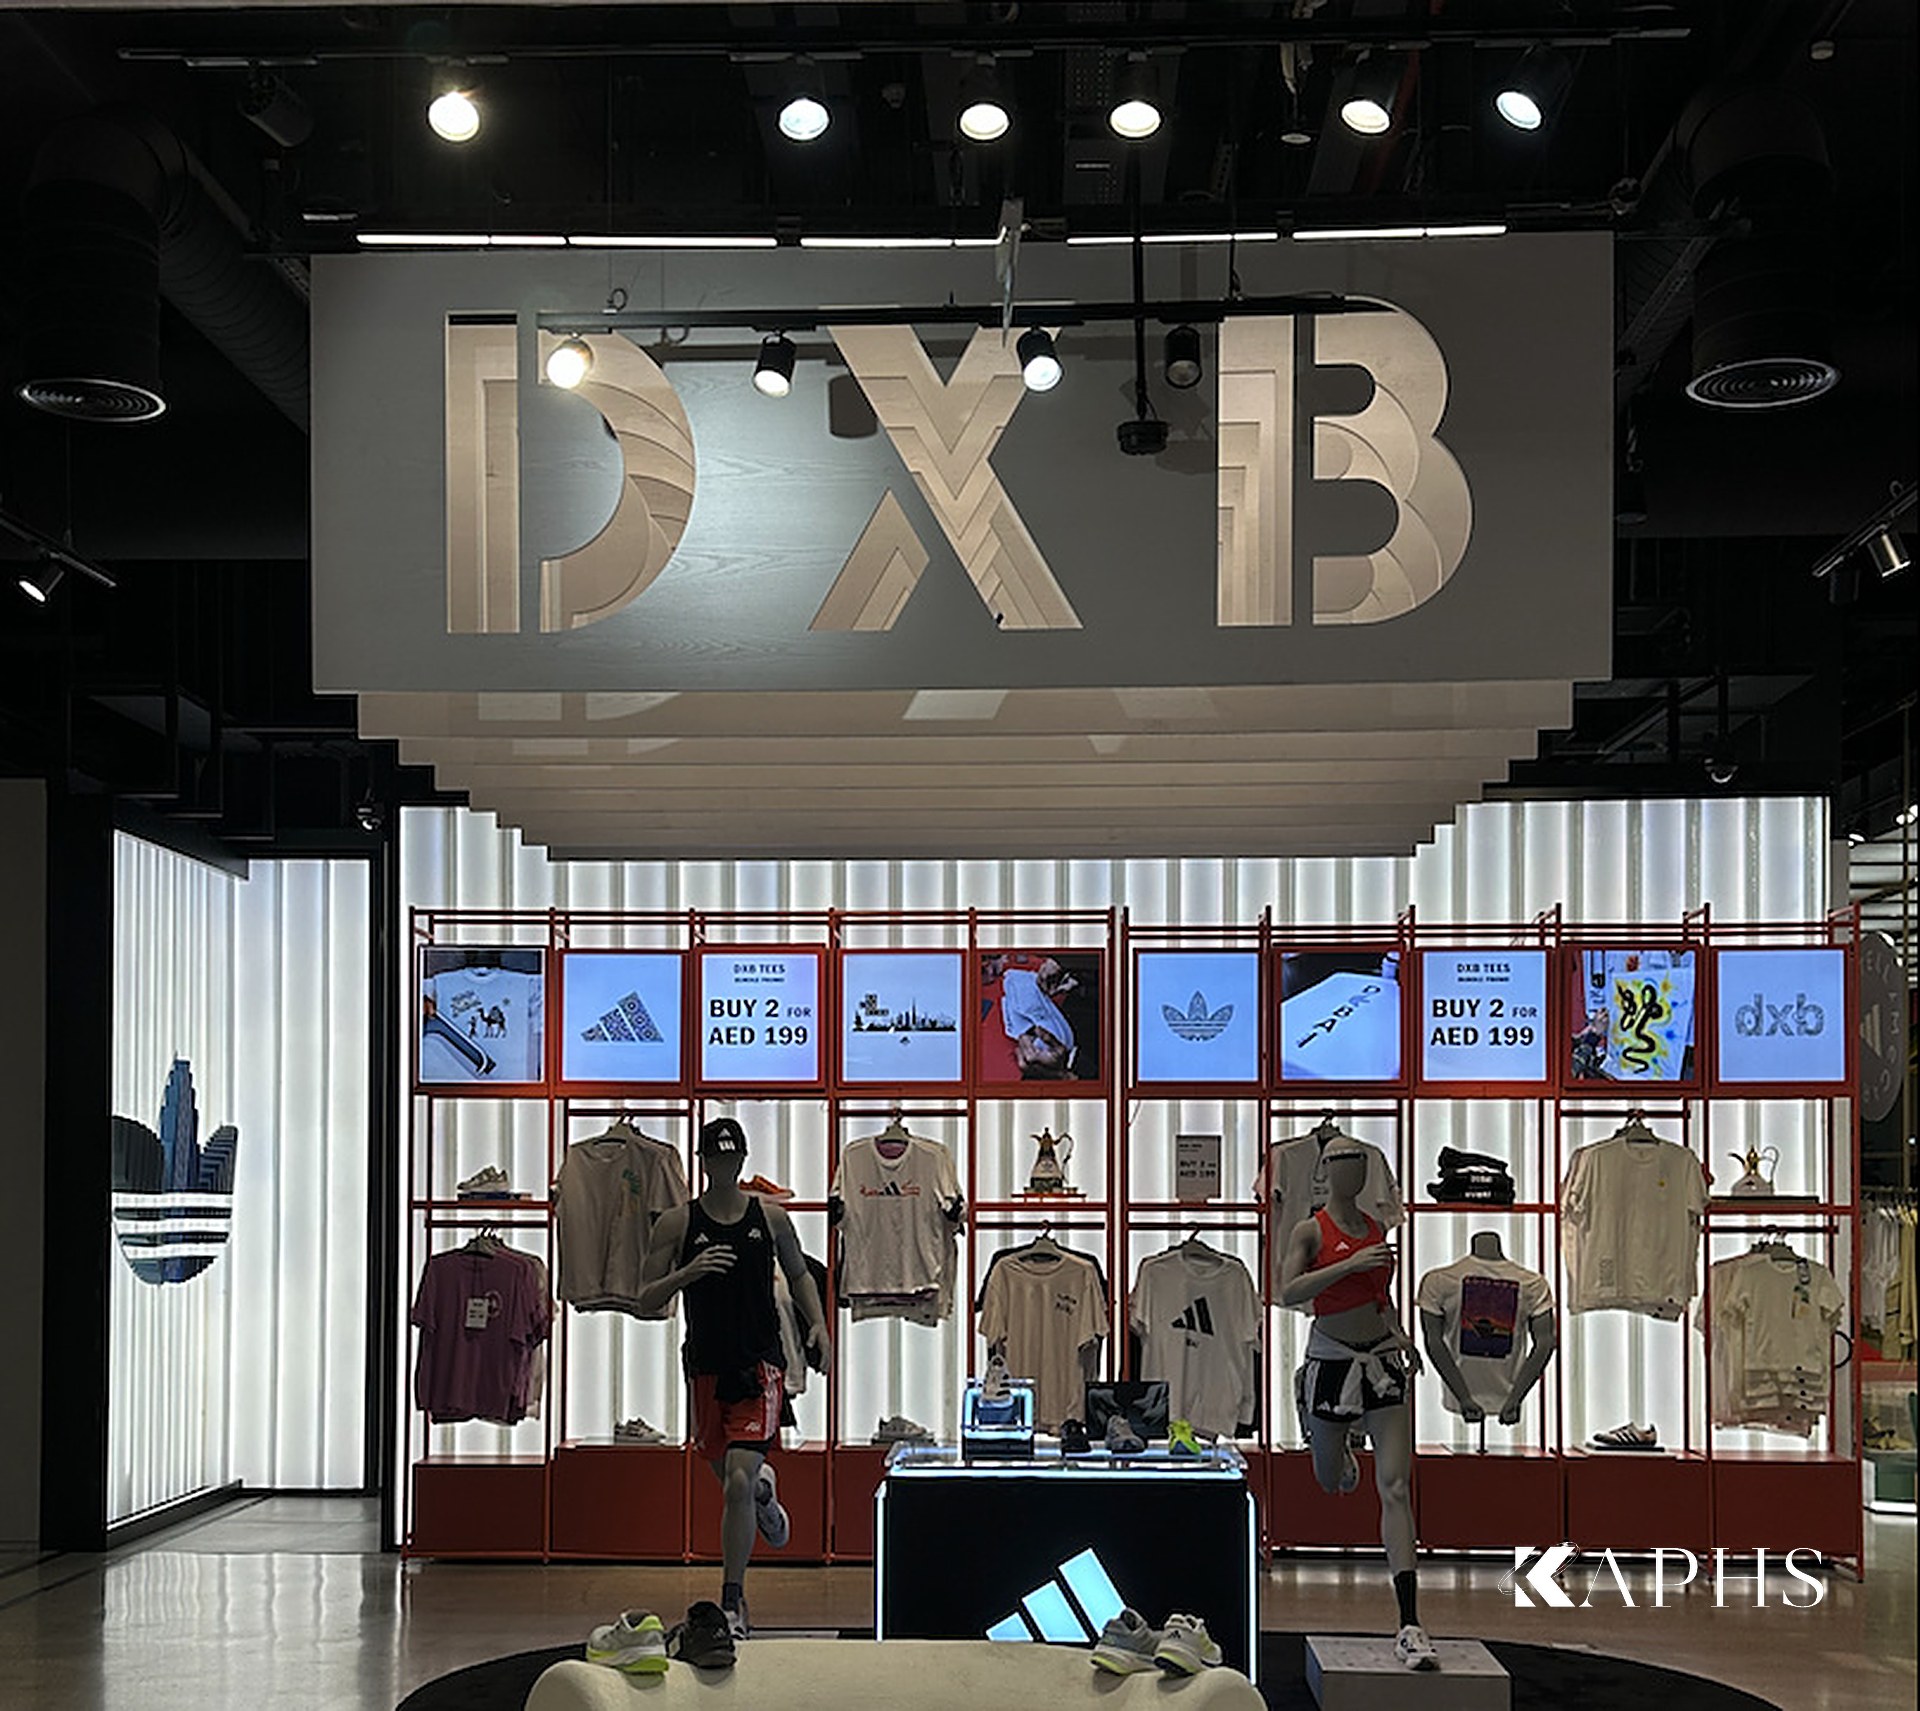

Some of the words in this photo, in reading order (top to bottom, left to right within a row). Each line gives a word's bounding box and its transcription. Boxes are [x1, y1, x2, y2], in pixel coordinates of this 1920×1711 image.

[446, 295, 1474, 634] DXB
[733, 963, 757, 974] DXB
[759, 963, 786, 974] TEES
[1457, 963, 1480, 973] DXB
[1483, 963, 1511, 973] TEES
[710, 999, 757, 1018] BUY
[765, 999, 779, 1018] 2
[787, 1007, 812, 1018] FOR
[1432, 999, 1481, 1018] BUY
[1489, 999, 1504, 1018] 2
[1512, 1007, 1538, 1018] FOR
[1734, 992, 1825, 1036] dxb
[708, 1026, 755, 1045] AED
[765, 1026, 808, 1045] 199
[1430, 1026, 1479, 1046] AED
[1488, 1026, 1534, 1046] 199
